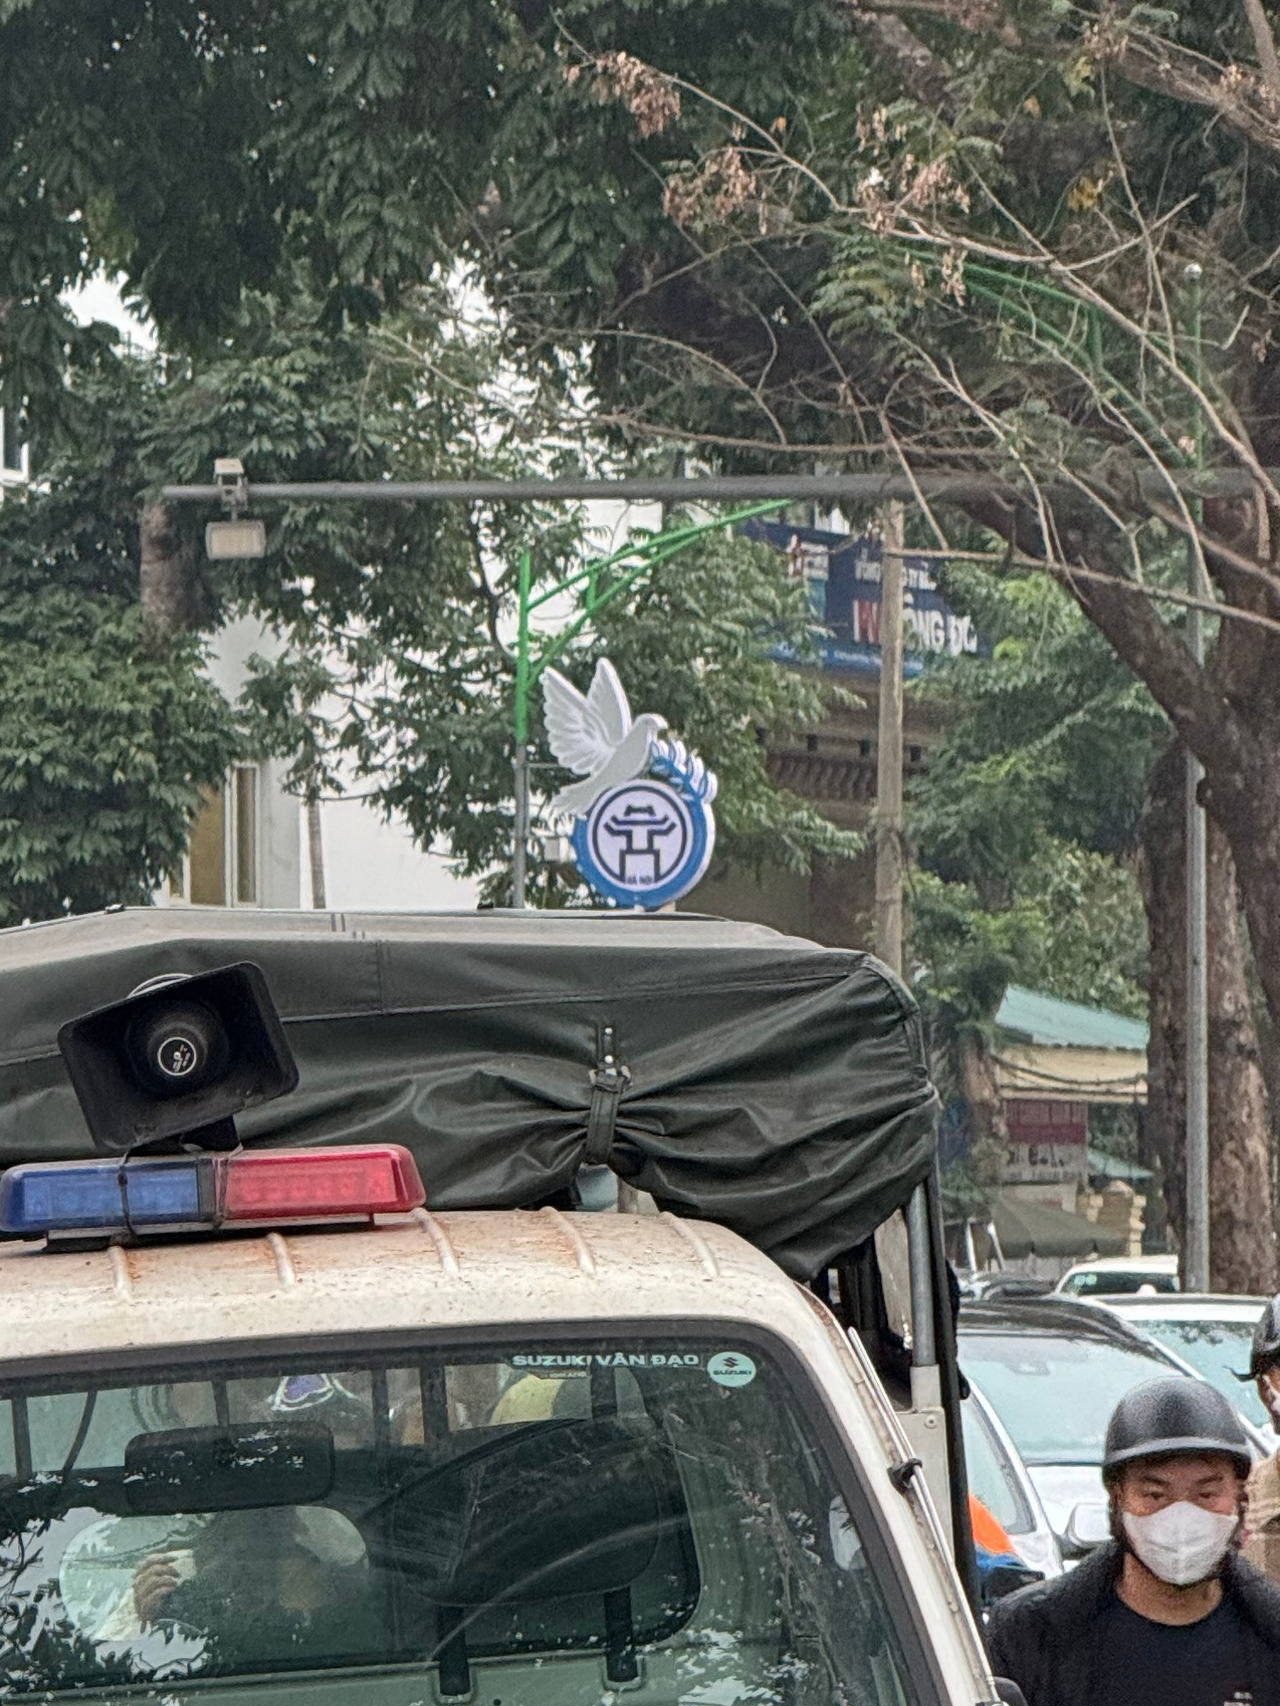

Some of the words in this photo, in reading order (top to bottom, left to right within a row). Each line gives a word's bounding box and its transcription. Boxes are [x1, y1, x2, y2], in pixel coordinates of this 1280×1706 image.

[512, 1355, 592, 1367] SUZUKI
[596, 1352, 646, 1366] VÂN
[651, 1354, 699, 1368] ĐẠO
